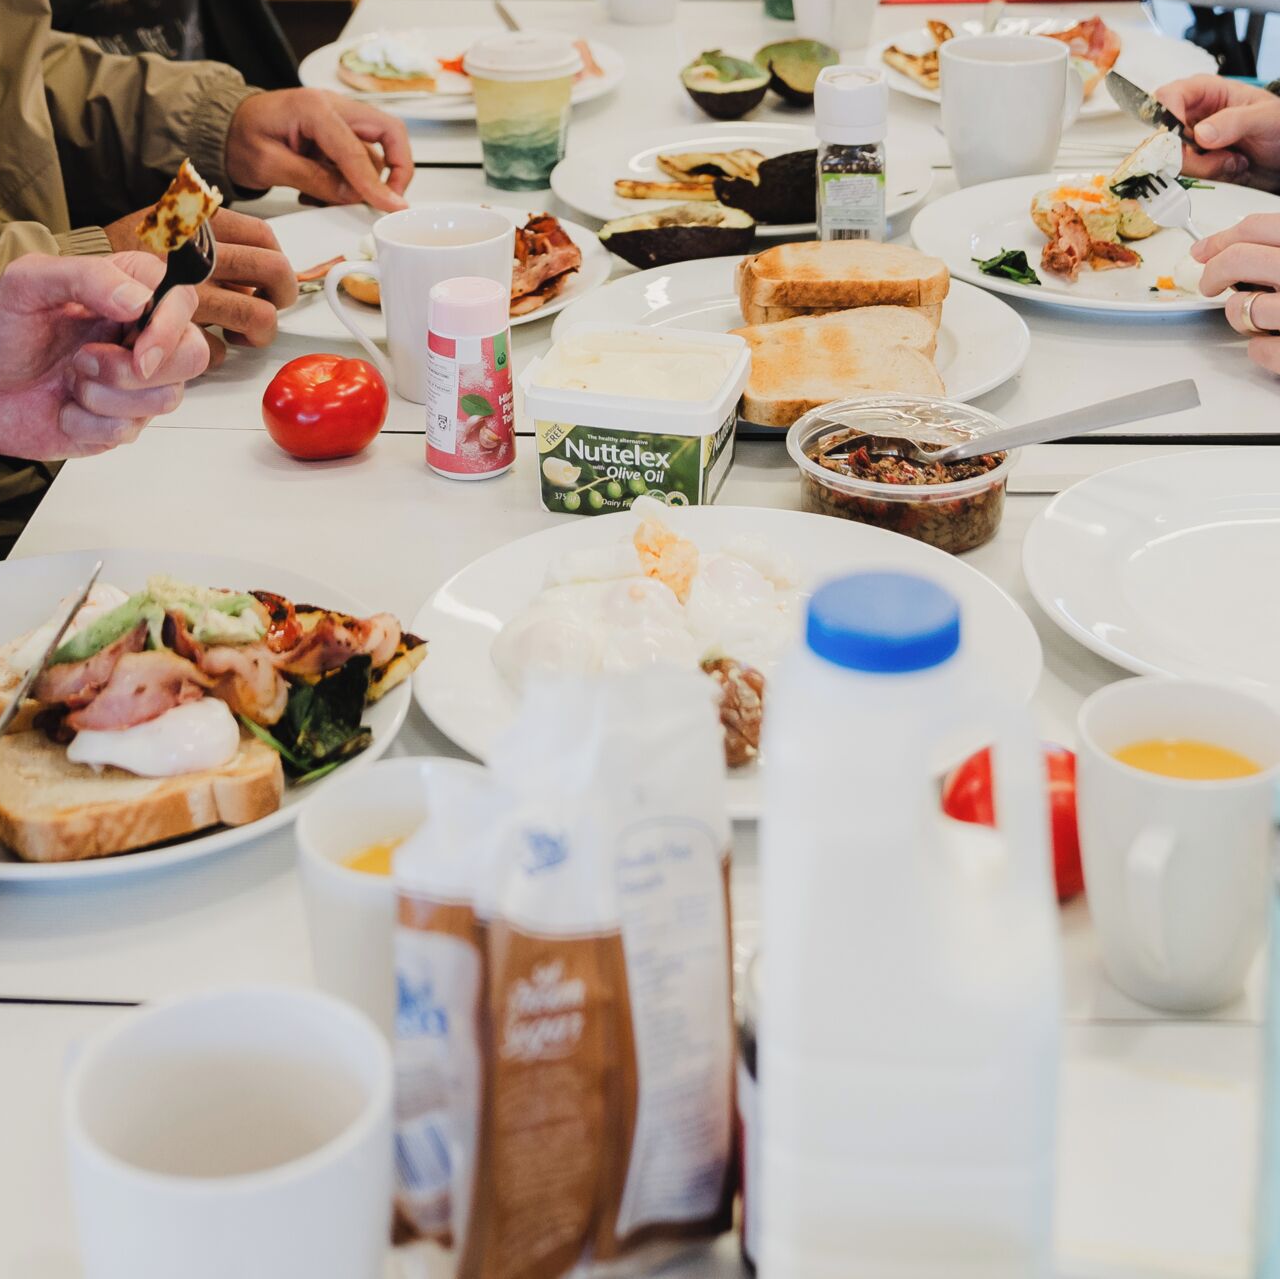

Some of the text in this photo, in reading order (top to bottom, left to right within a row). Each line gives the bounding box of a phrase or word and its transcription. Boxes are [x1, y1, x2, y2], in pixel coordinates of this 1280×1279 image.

[546, 428, 565, 446] FREE
[598, 435, 618, 443] healthy
[565, 437, 671, 469] Nuttelex
[606, 466, 641, 481] Olive
[644, 469, 665, 483] Oil
[602, 499, 621, 508] Dairy
